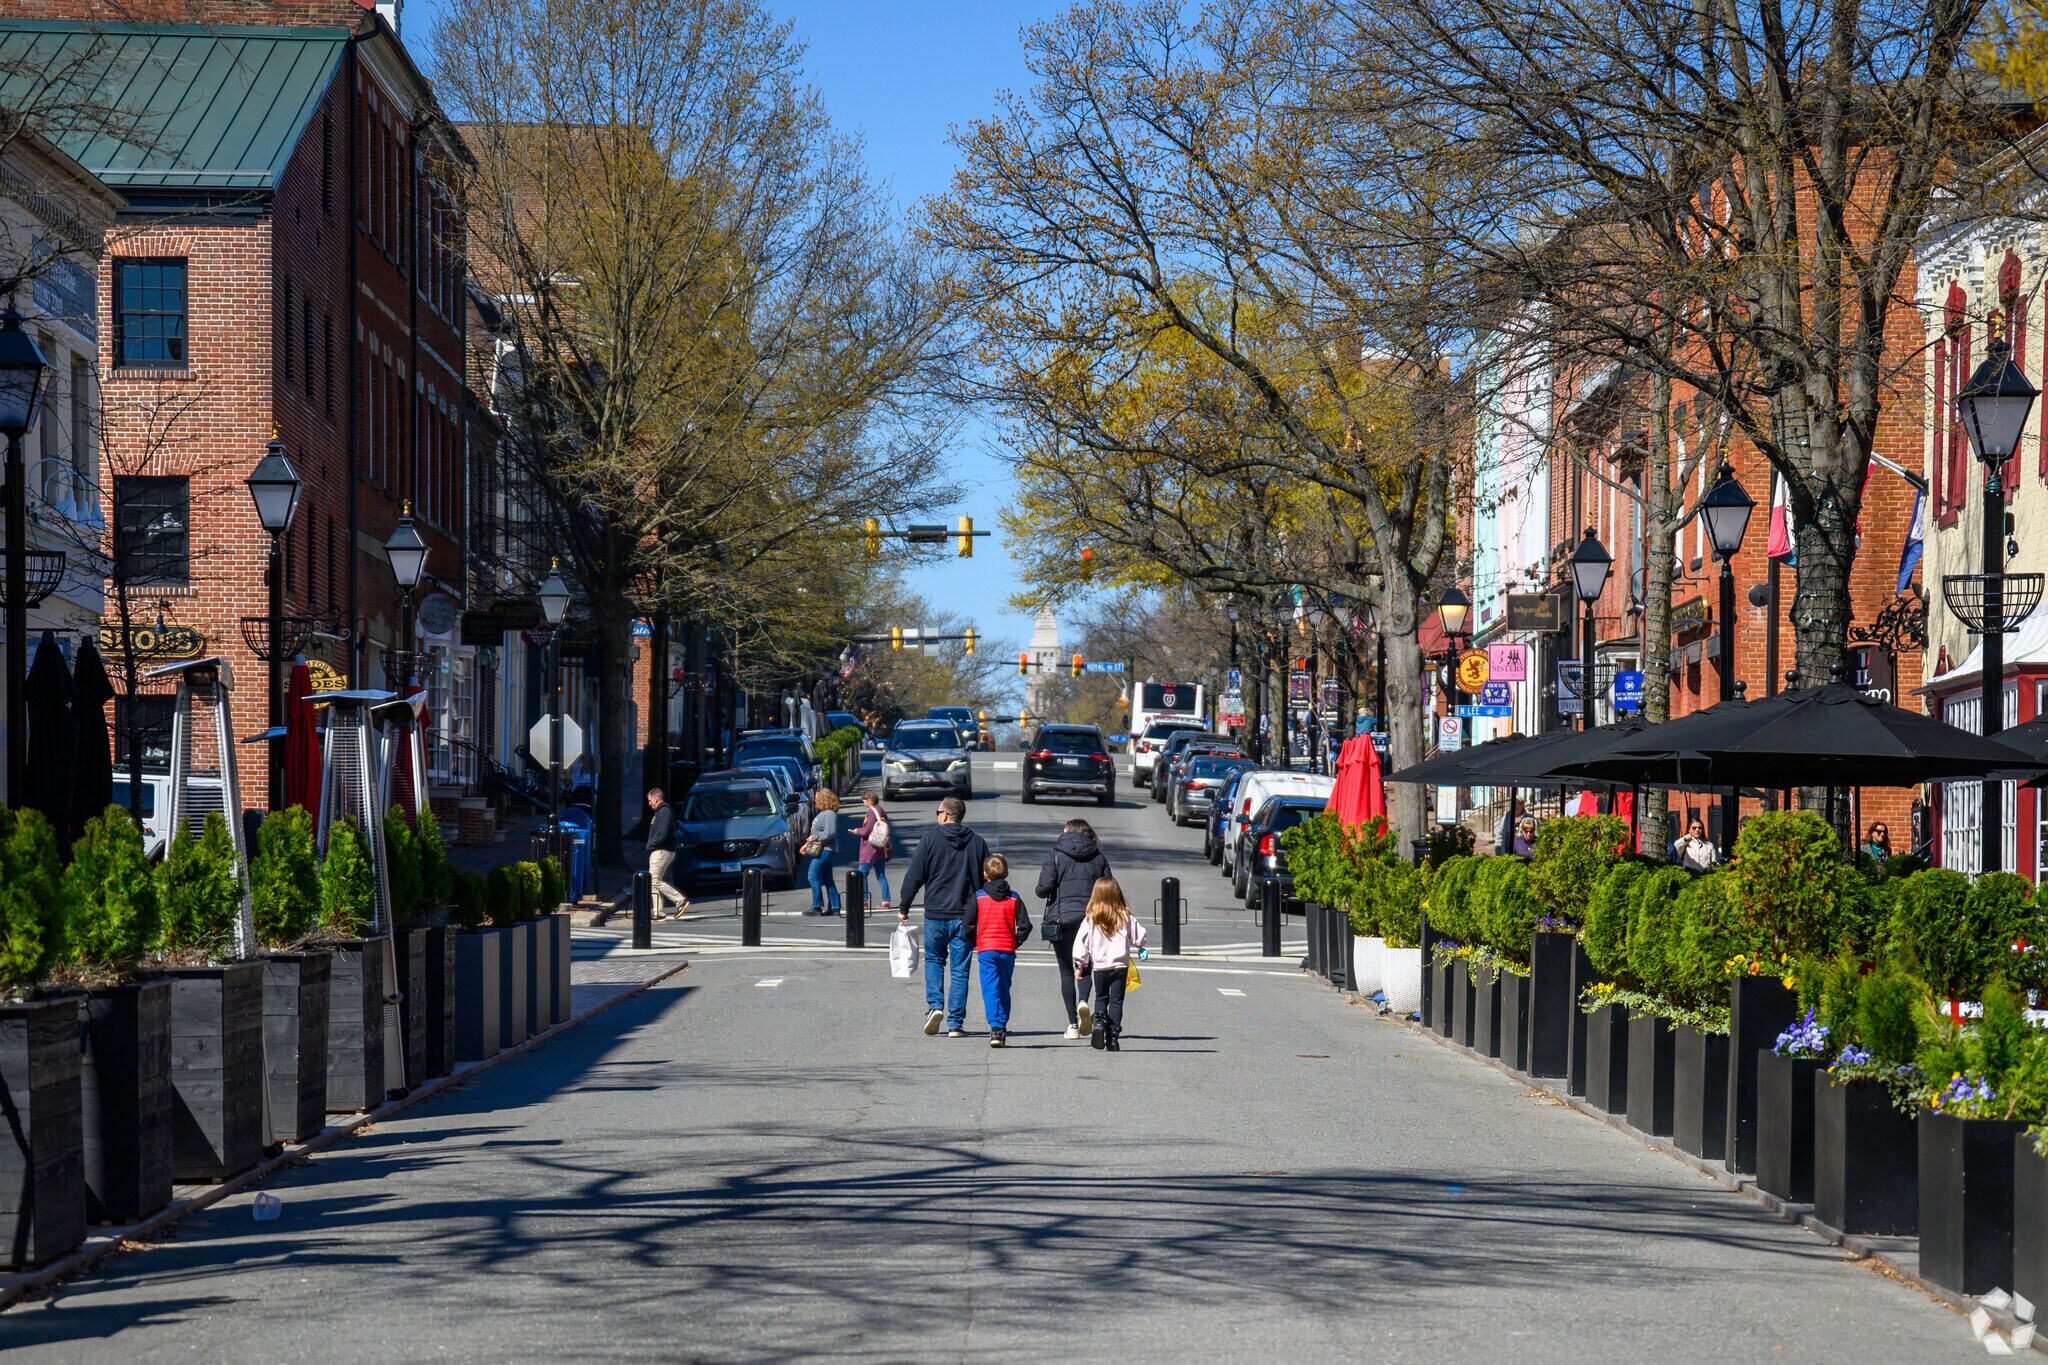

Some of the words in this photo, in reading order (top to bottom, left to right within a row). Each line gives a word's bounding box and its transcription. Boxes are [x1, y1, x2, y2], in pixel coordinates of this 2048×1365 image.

[1492, 649, 1504, 665] 3
[1086, 663, 1105, 671] ROYAL
[1113, 663, 1122, 671] ST
[1491, 665, 1524, 673] SISTERS
[283, 679, 346, 690] SOES
[1459, 706, 1466, 715] N
[1467, 706, 1480, 715] LEE
